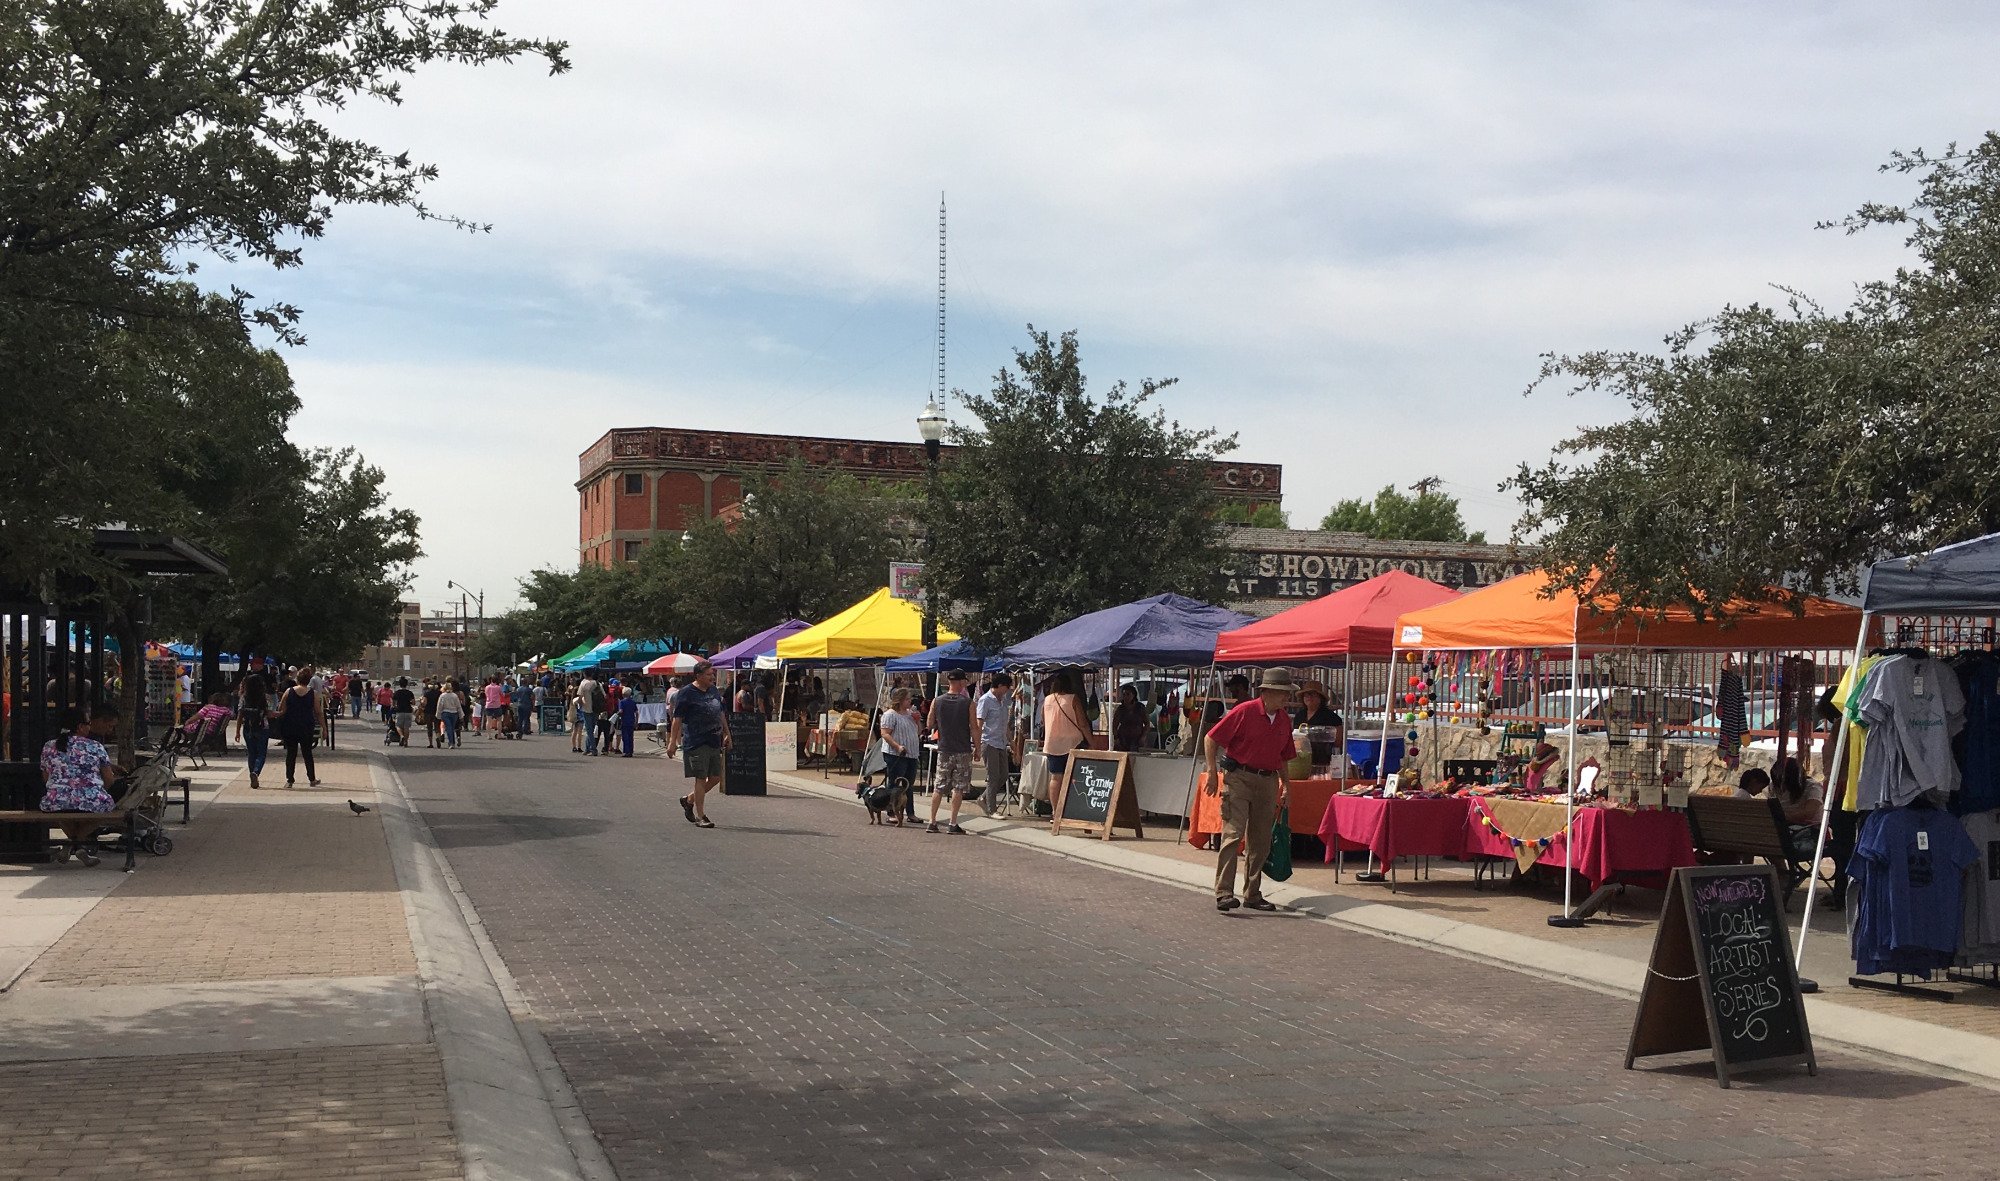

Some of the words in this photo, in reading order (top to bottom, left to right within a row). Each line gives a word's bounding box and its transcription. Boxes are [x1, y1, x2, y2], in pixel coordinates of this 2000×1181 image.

[1259, 553, 1447, 583] SHOWROOM
[1226, 579, 1259, 594] AT
[1279, 581, 1320, 597] 115
[1081, 765, 1094, 776] The
[1090, 796, 1108, 812] Guy
[1696, 882, 1718, 901] NOW
[1718, 884, 1760, 902] AVAILABLE
[1706, 905, 1768, 938] LOCAL
[1710, 940, 1772, 974] ARTIST
[1717, 976, 1781, 1017] SERIES
